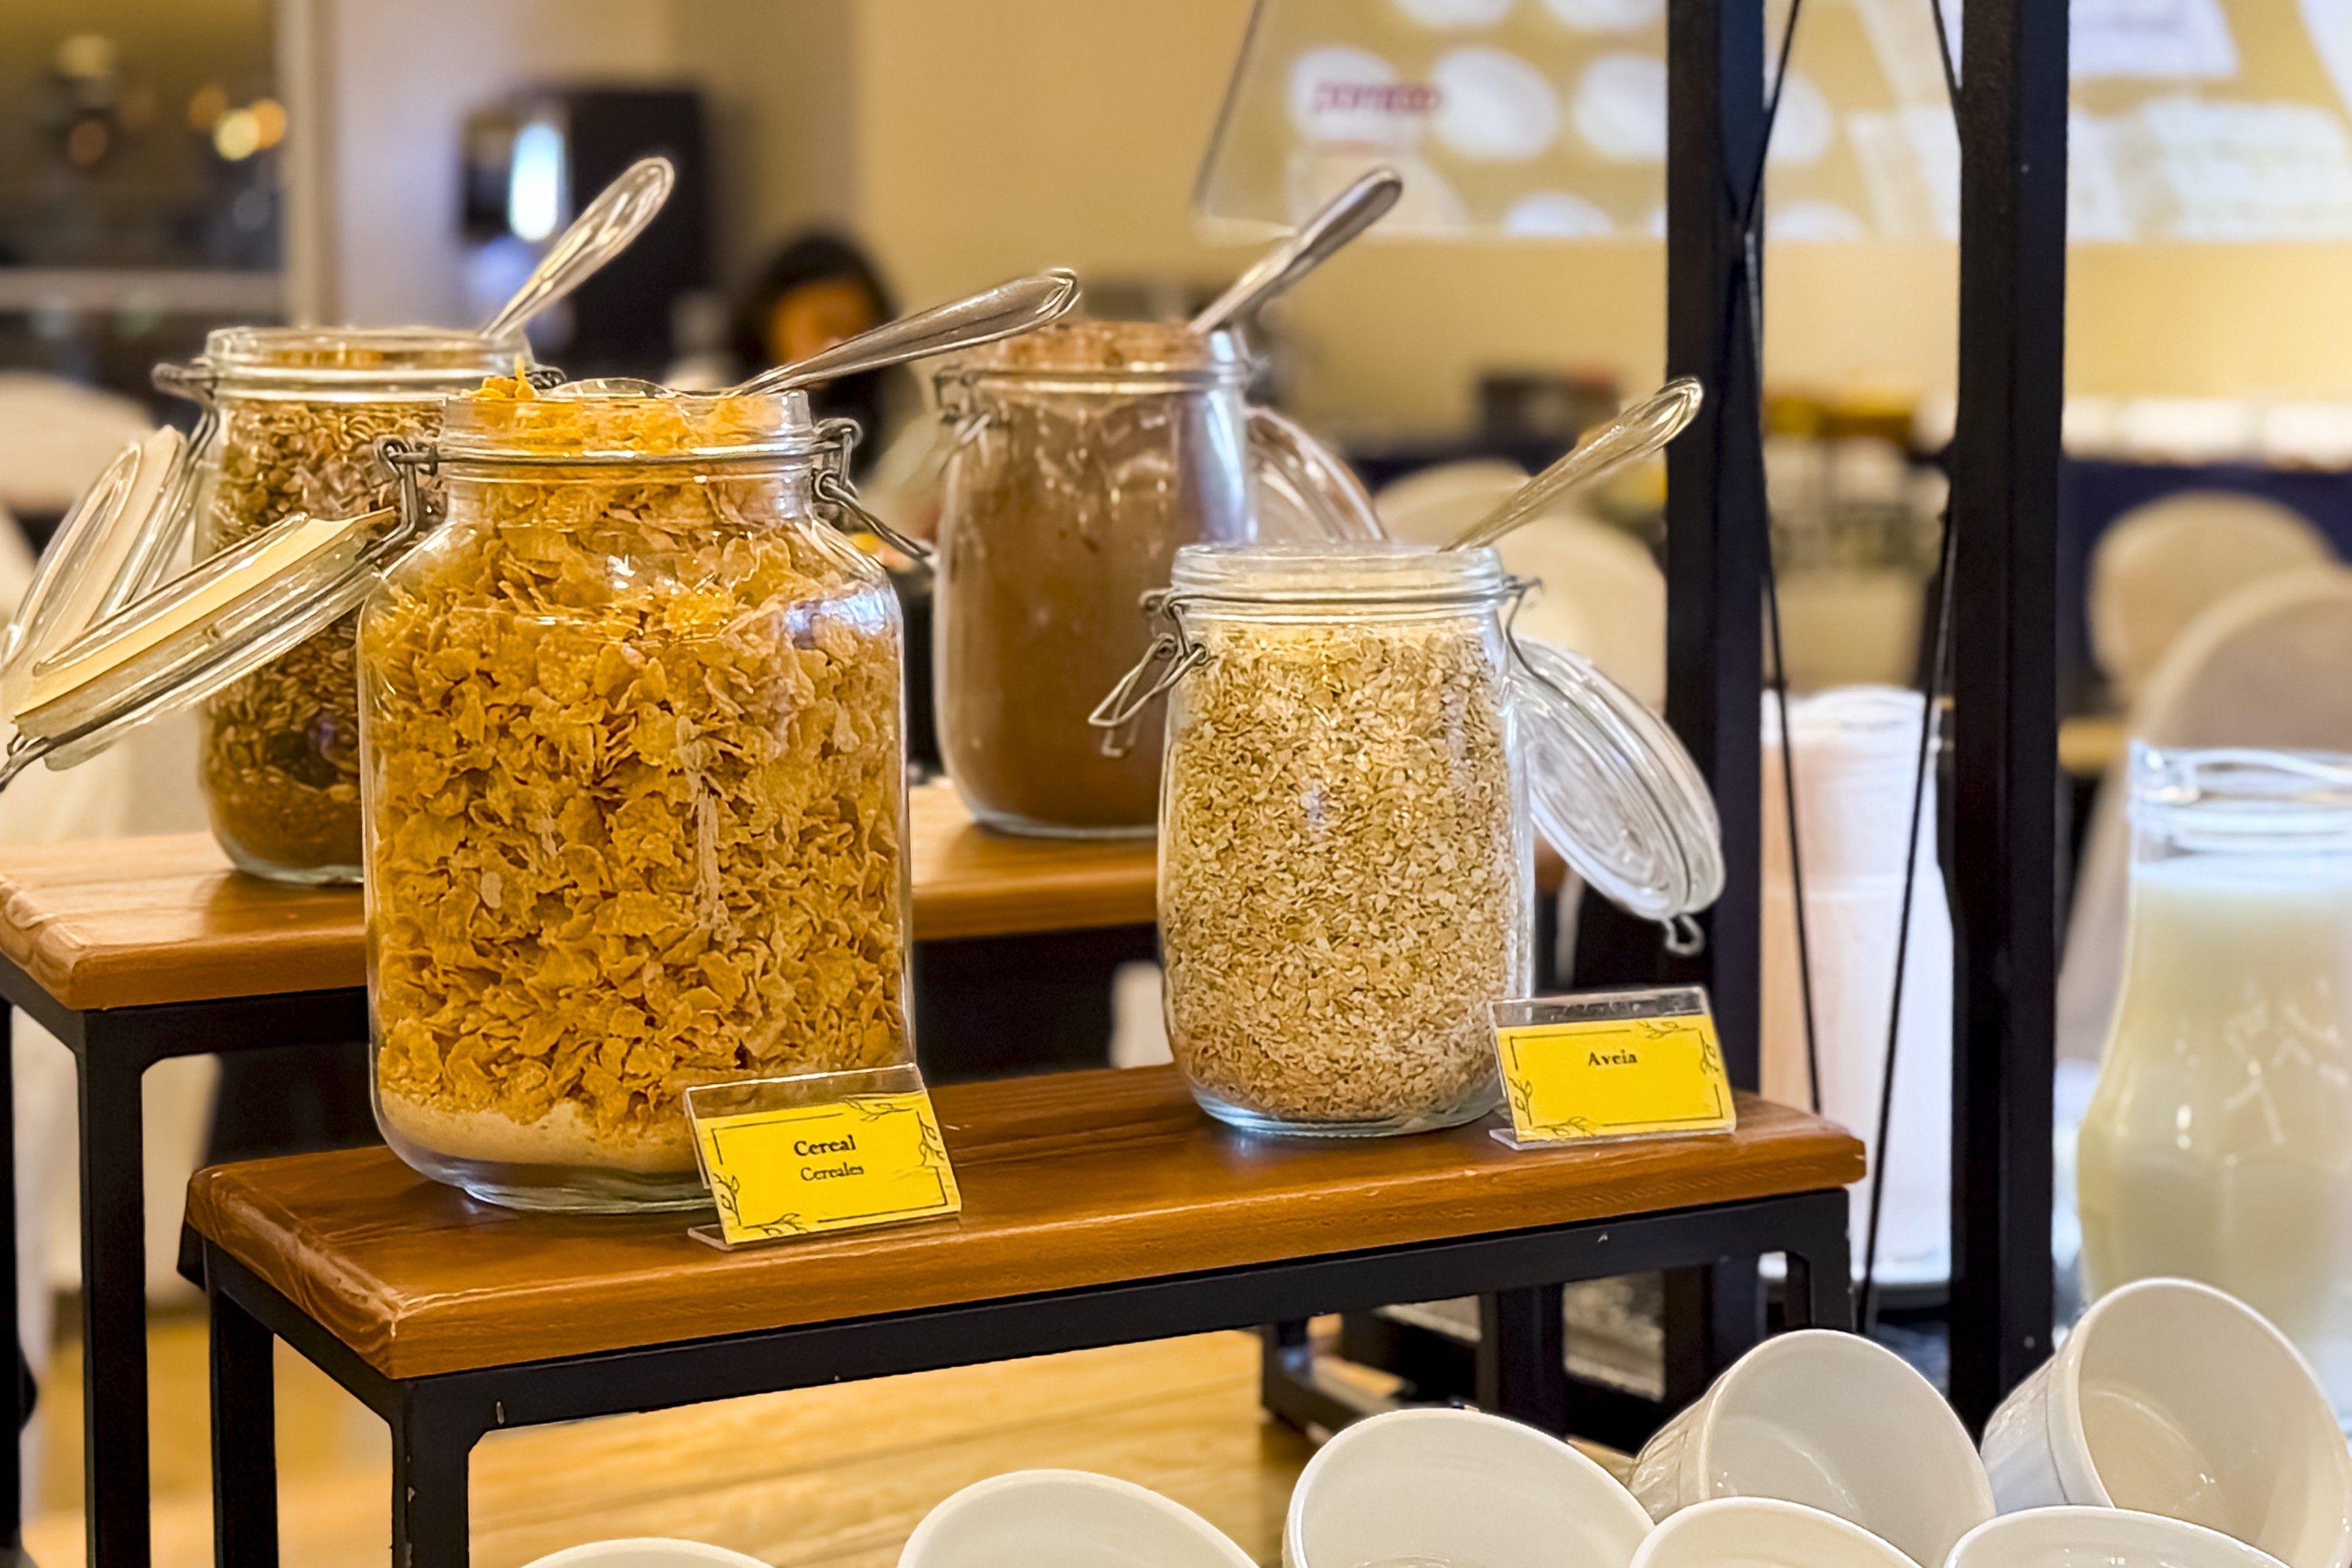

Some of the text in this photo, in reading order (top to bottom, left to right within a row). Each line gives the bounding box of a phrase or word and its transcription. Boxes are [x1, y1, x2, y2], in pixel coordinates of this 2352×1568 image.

[1588, 1049, 1637, 1067] Aveia
[794, 1134, 856, 1156] Cereal
[800, 1162, 864, 1182] Cereales
